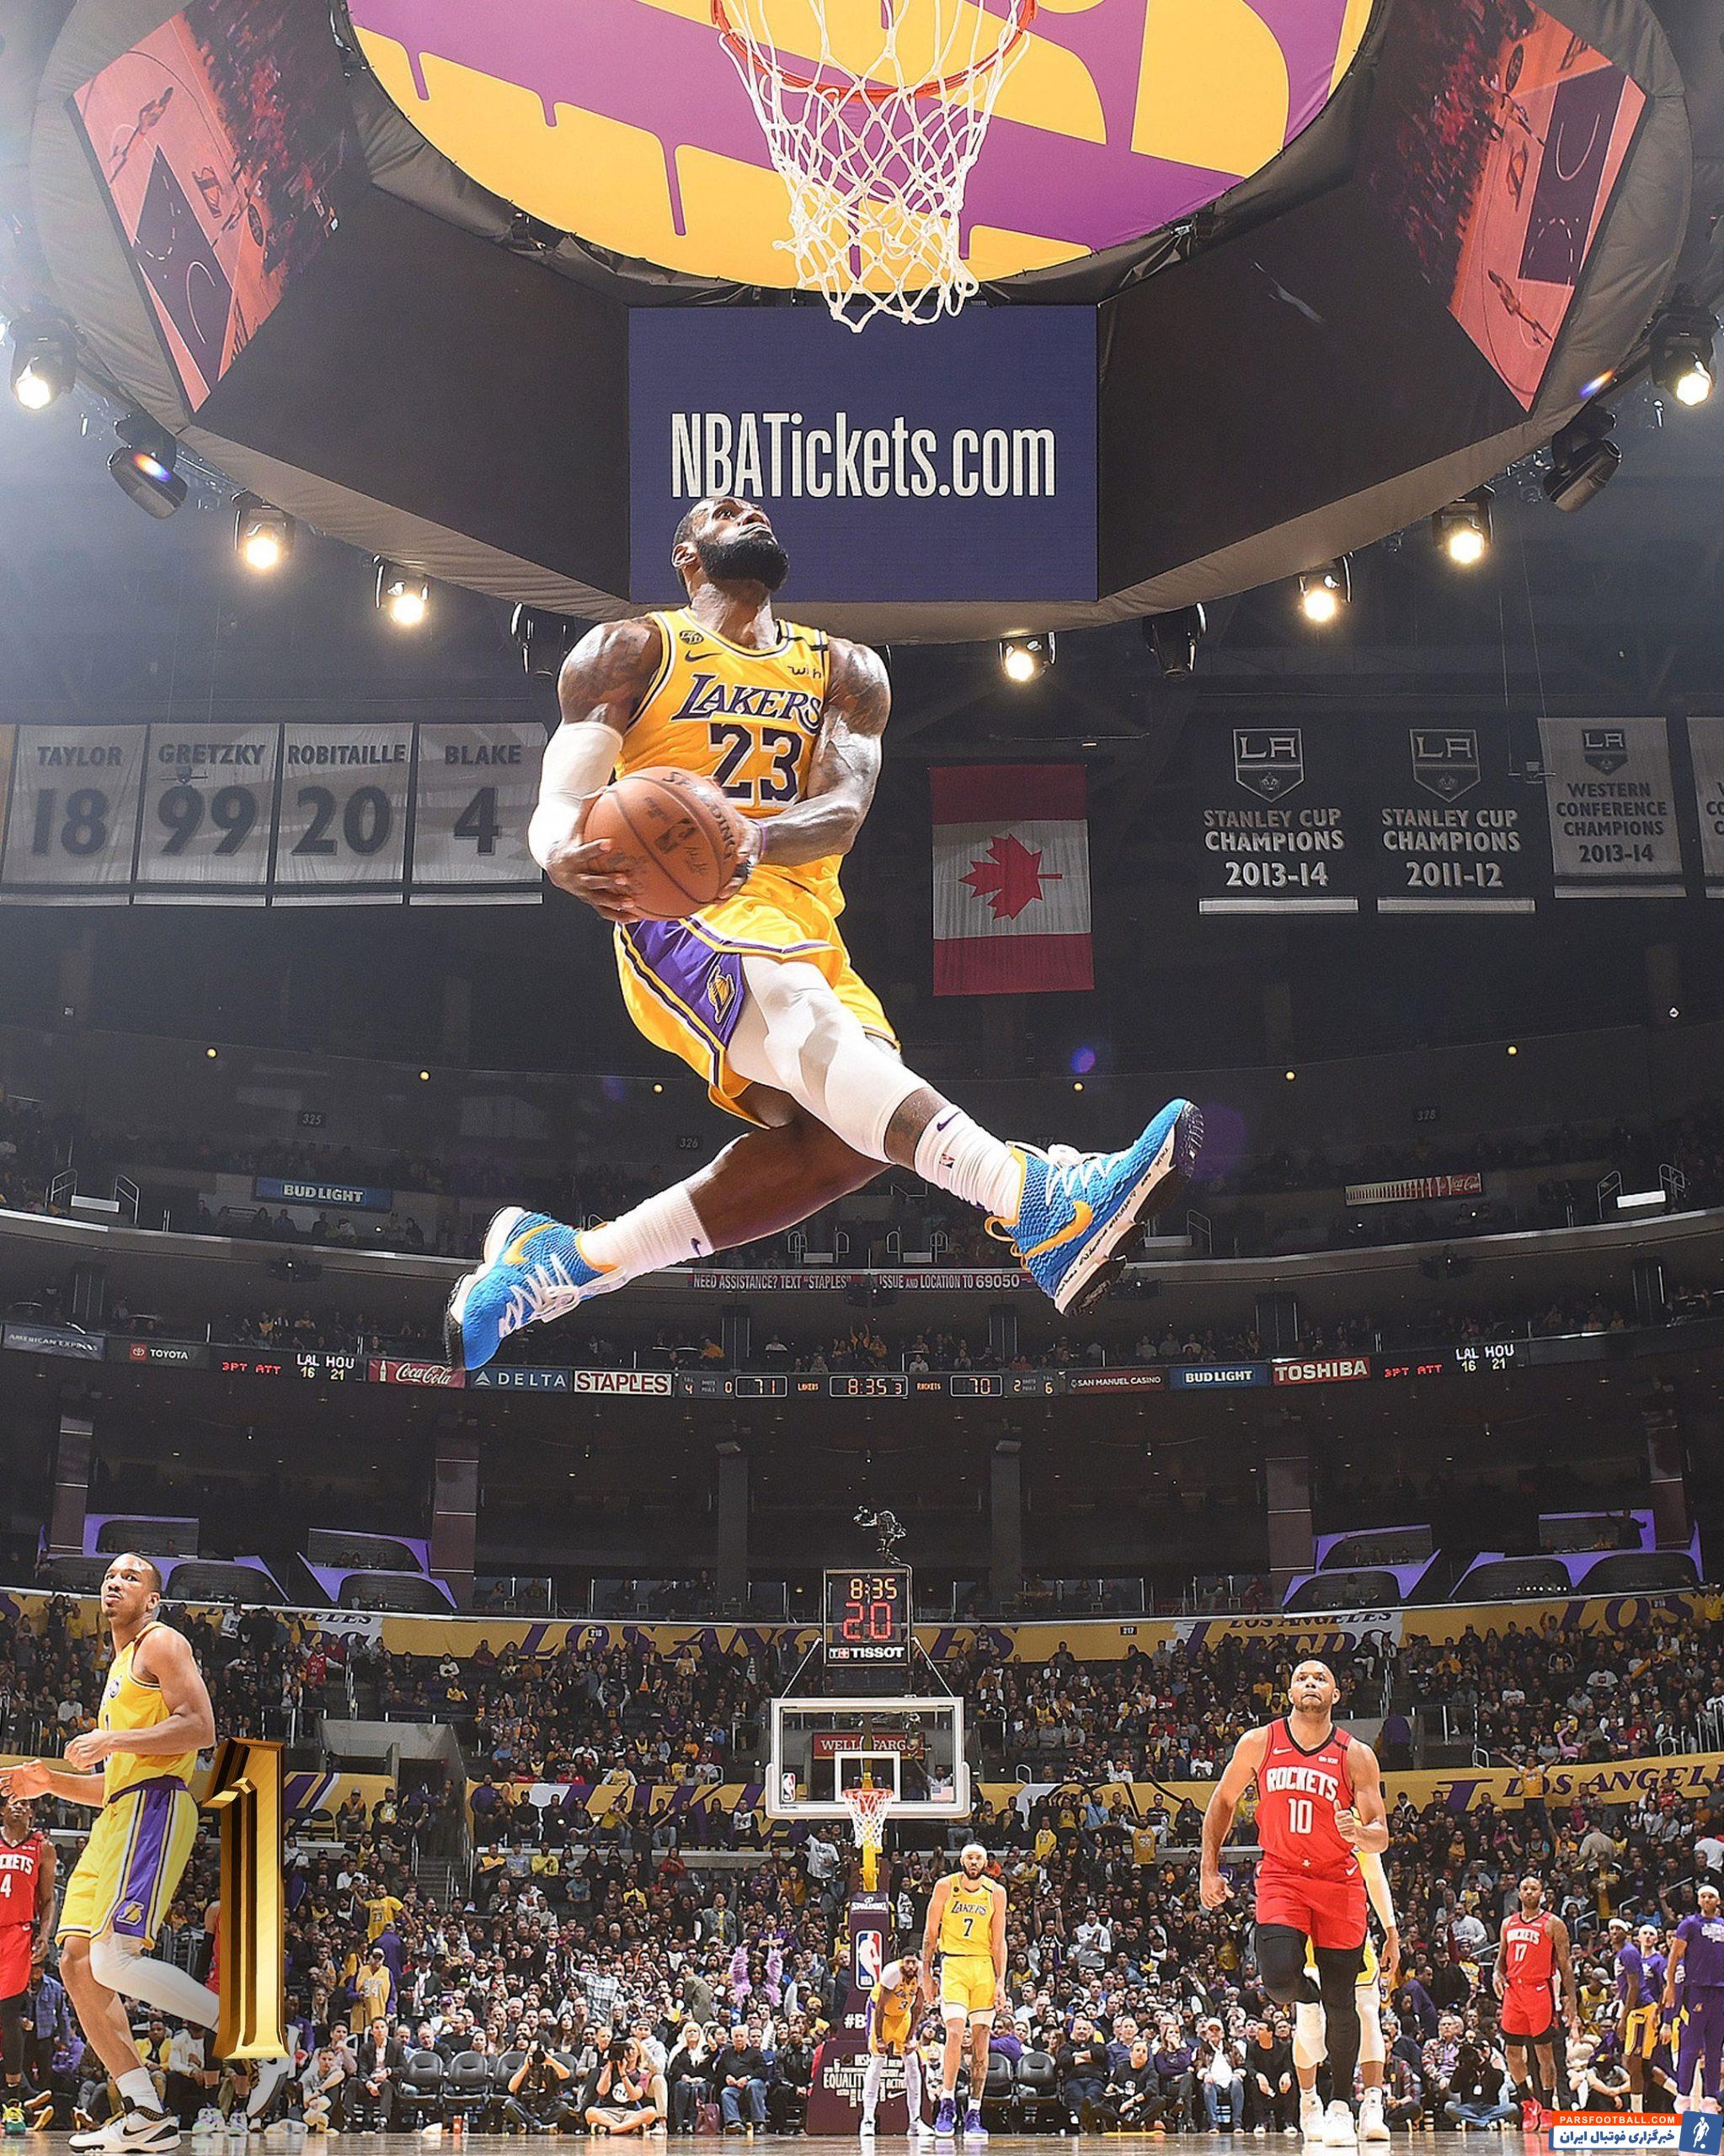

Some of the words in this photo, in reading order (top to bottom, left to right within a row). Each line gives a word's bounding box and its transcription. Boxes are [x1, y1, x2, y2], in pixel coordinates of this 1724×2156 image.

[670, 412, 1055, 498] NBATickets.com
[787, 664, 822, 679] wih
[671, 674, 824, 735] LAKERS
[1240, 737, 1296, 758] LA
[1417, 737, 1472, 758] LA
[1584, 733, 1624, 748] LA
[38, 746, 123, 766] TAYLOR
[157, 744, 266, 766] GRETZKY
[287, 744, 406, 766] ROBITAILLE
[444, 744, 521, 766] BLAKE
[709, 723, 803, 807] 23
[1567, 782, 1651, 798] WESTERN
[662, 771, 735, 860] SPDING
[1204, 809, 1292, 828] STANLEY
[1300, 808, 1342, 826] CUP
[1381, 808, 1469, 827] STANLEY
[1476, 808, 1518, 827] CUP
[1556, 802, 1668, 817] CONFERENCE
[32, 788, 110, 857] 18
[157, 785, 254, 857] 99
[291, 786, 394, 857] 20
[453, 787, 499, 856] 4
[1564, 821, 1664, 836] CHAMPIONS
[1204, 830, 1345, 852] CHAMPIONS
[1383, 830, 1522, 852] CHAMPIONS
[1578, 845, 1654, 863] 2013-14
[1225, 862, 1329, 888] 2013-14
[1406, 862, 1504, 888] 2011-12
[302, 1113, 322, 1125] 325
[680, 1138, 698, 1148] 326
[283, 1184, 316, 1198] BUD
[318, 1187, 363, 1203] LIGHT
[693, 1274, 717, 1289] NEED
[719, 1274, 777, 1289] ASSISTANCE?
[779, 1275, 802, 1289] TEXT
[878, 1274, 904, 1289] ISSUE
[905, 1278, 918, 1289] AND
[920, 1275, 961, 1289] LOCATION
[963, 1274, 974, 1289] TO
[975, 1274, 1020, 1289] 69050
[8, 1333, 56, 1347] AMERICAN
[150, 1348, 189, 1360] TOYOTA
[297, 1353, 319, 1367] LAL
[325, 1356, 355, 1369] HOU
[1455, 1348, 1478, 1361] LAL
[1484, 1344, 1515, 1359] HOU
[222, 1362, 248, 1372] 3PT
[255, 1364, 281, 1375] ATT
[301, 1368, 315, 1379] 16
[330, 1369, 344, 1381] 21
[1274, 1360, 1369, 1382] TOSHIBA
[1384, 1367, 1409, 1379] 3PT
[1417, 1364, 1443, 1375] ATT
[1461, 1361, 1476, 1373] 16
[1492, 1358, 1507, 1370] 21
[498, 1372, 566, 1387] DELTA
[577, 1372, 669, 1394] STAPLES
[848, 1378, 887, 1395] 8:35
[969, 1378, 990, 1395] 70
[1185, 1371, 1214, 1384] BUD
[1215, 1370, 1253, 1383] LIGHT
[724, 1381, 733, 1394] 0
[755, 1379, 775, 1395] 71
[1045, 1382, 1054, 1395] 6
[850, 1577, 897, 1599] 8:35
[843, 1601, 891, 1640] 20
[1229, 1619, 1273, 1630] LOS
[663, 1626, 1015, 1662] ANGES
[850, 1646, 905, 1659] TISSOT
[1267, 1766, 1339, 1801] ROCKETS
[1288, 1798, 1312, 1834] 10
[0, 1873, 12, 1898] 4
[963, 1918, 974, 1937] 7
[1514, 1943, 1528, 1962] 17
